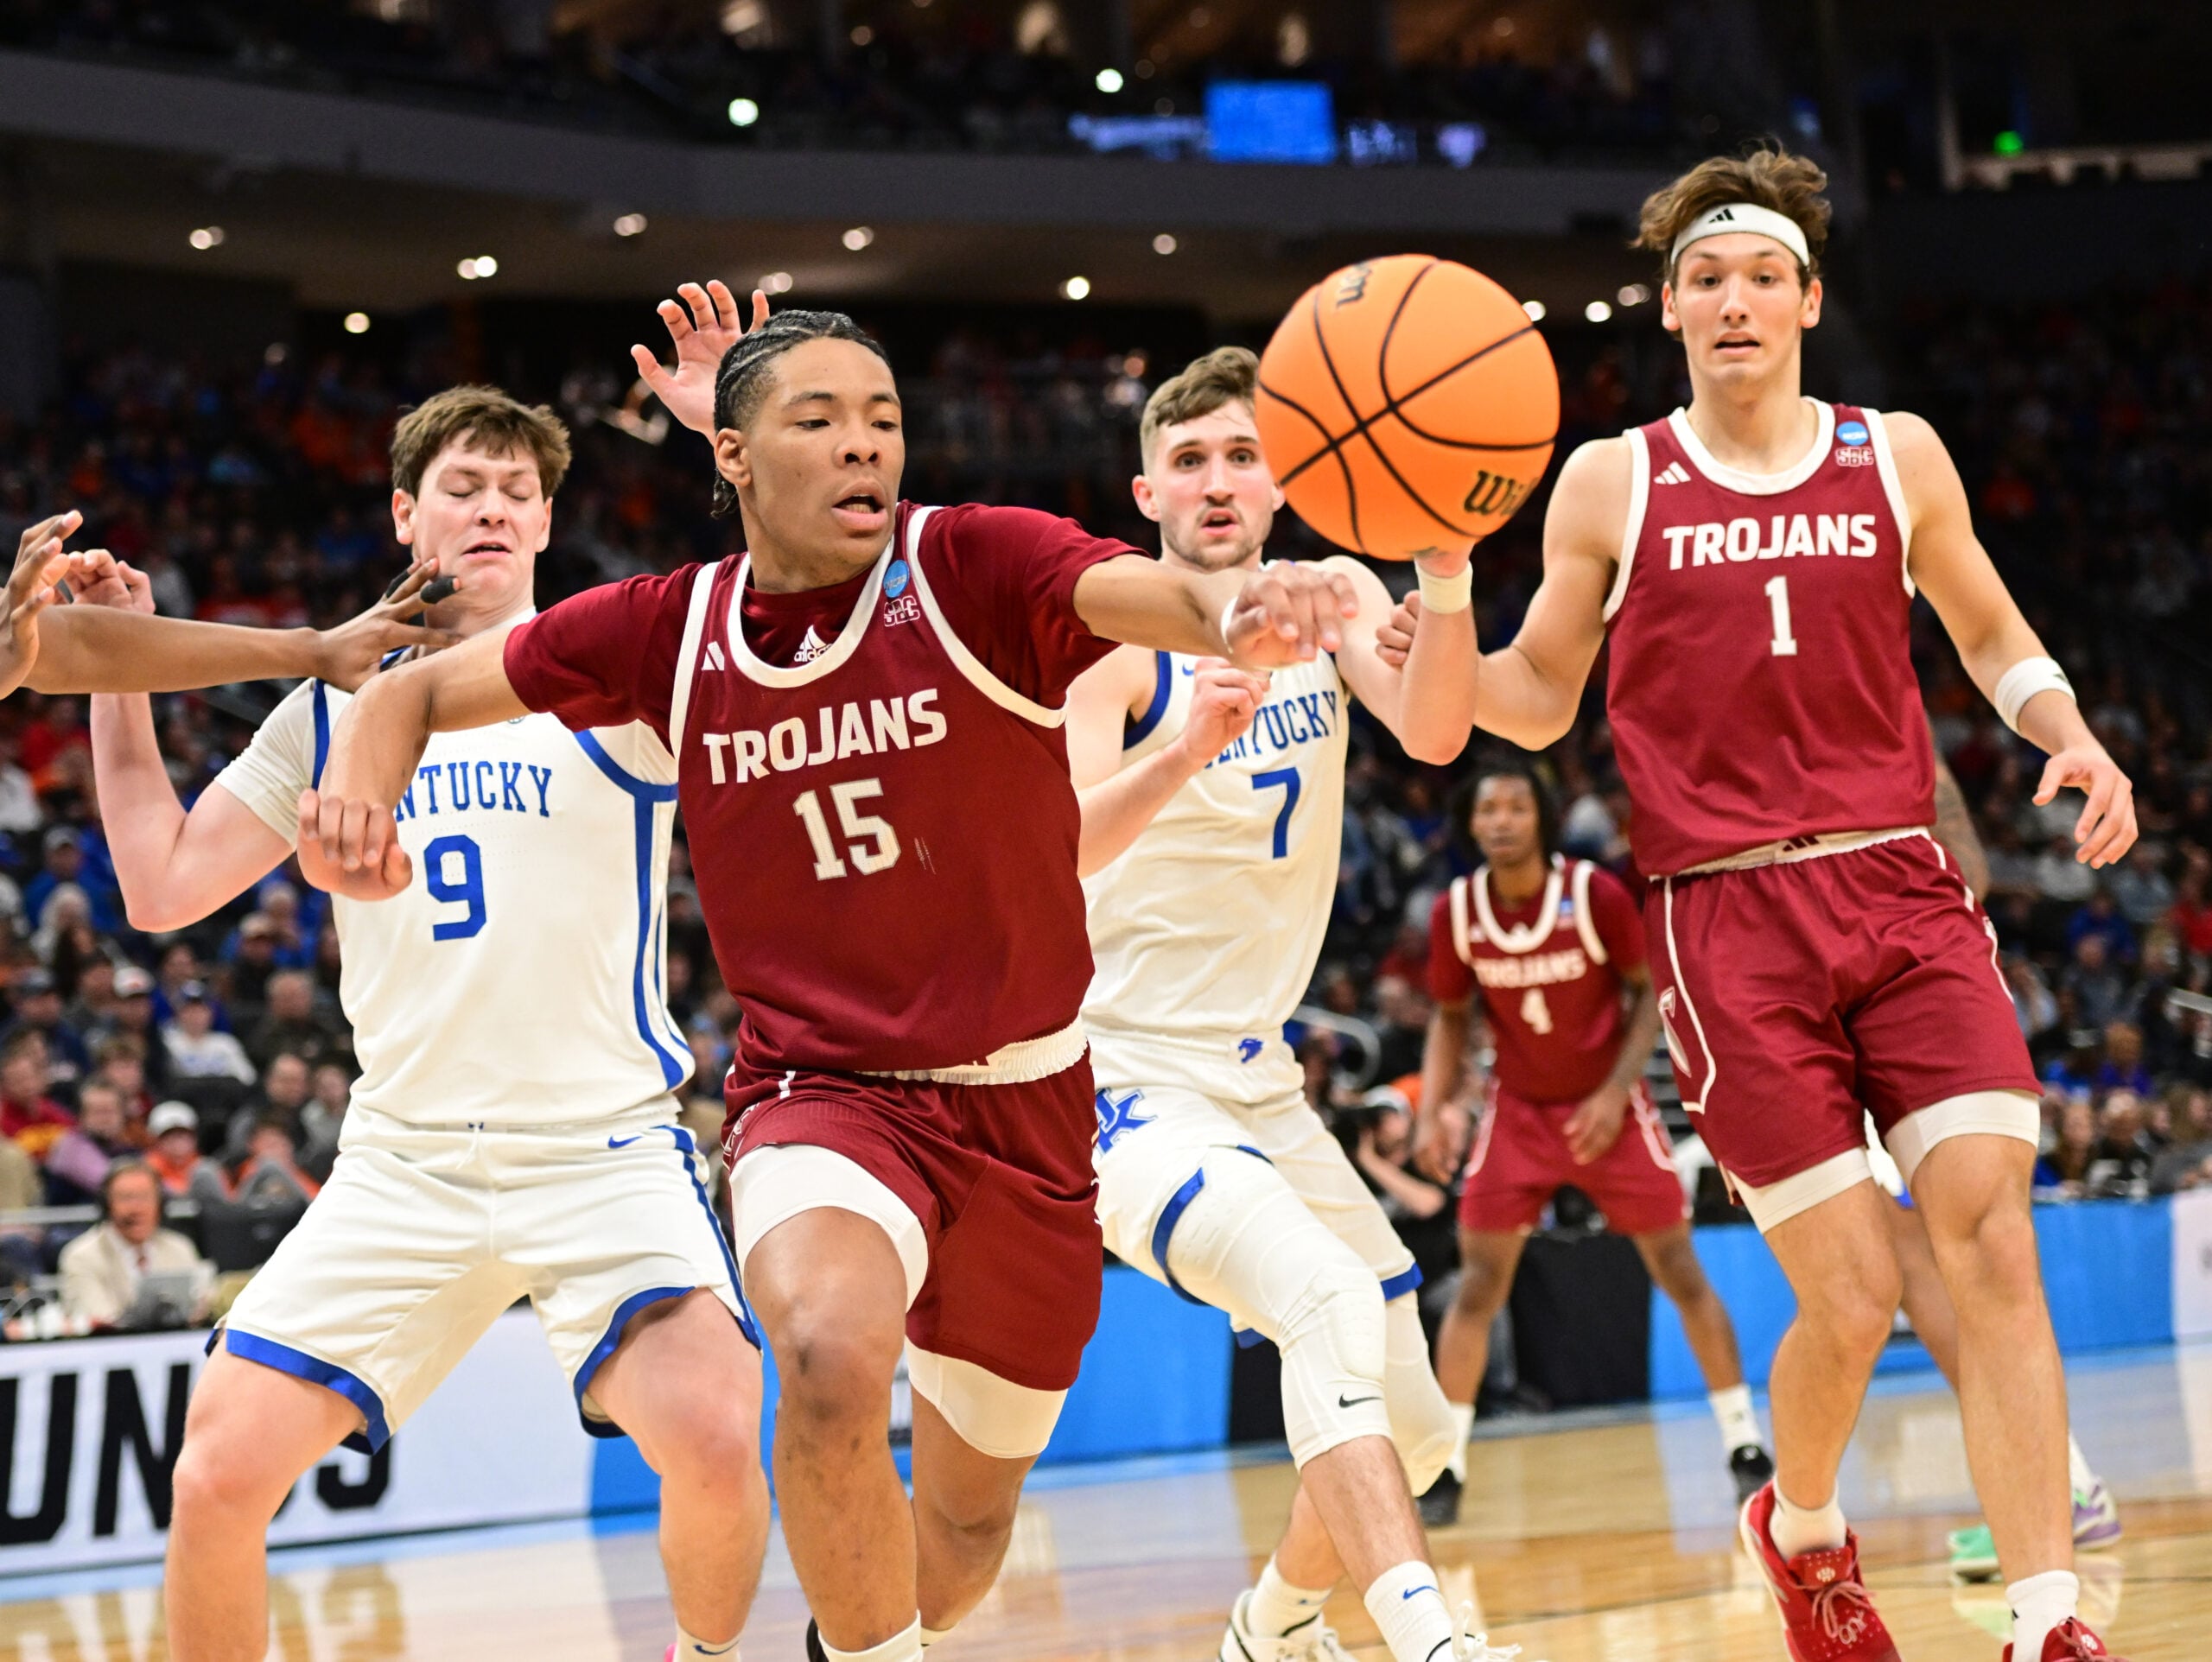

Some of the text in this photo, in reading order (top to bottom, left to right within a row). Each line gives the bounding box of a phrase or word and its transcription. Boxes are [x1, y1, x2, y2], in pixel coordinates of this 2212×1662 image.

[1662, 514, 1878, 570] TROJANS
[1764, 575, 1797, 657] 1
[702, 688, 948, 785] TROJANS
[792, 777, 902, 881] 15
[1251, 766, 1301, 860] 7
[423, 834, 486, 942] 9
